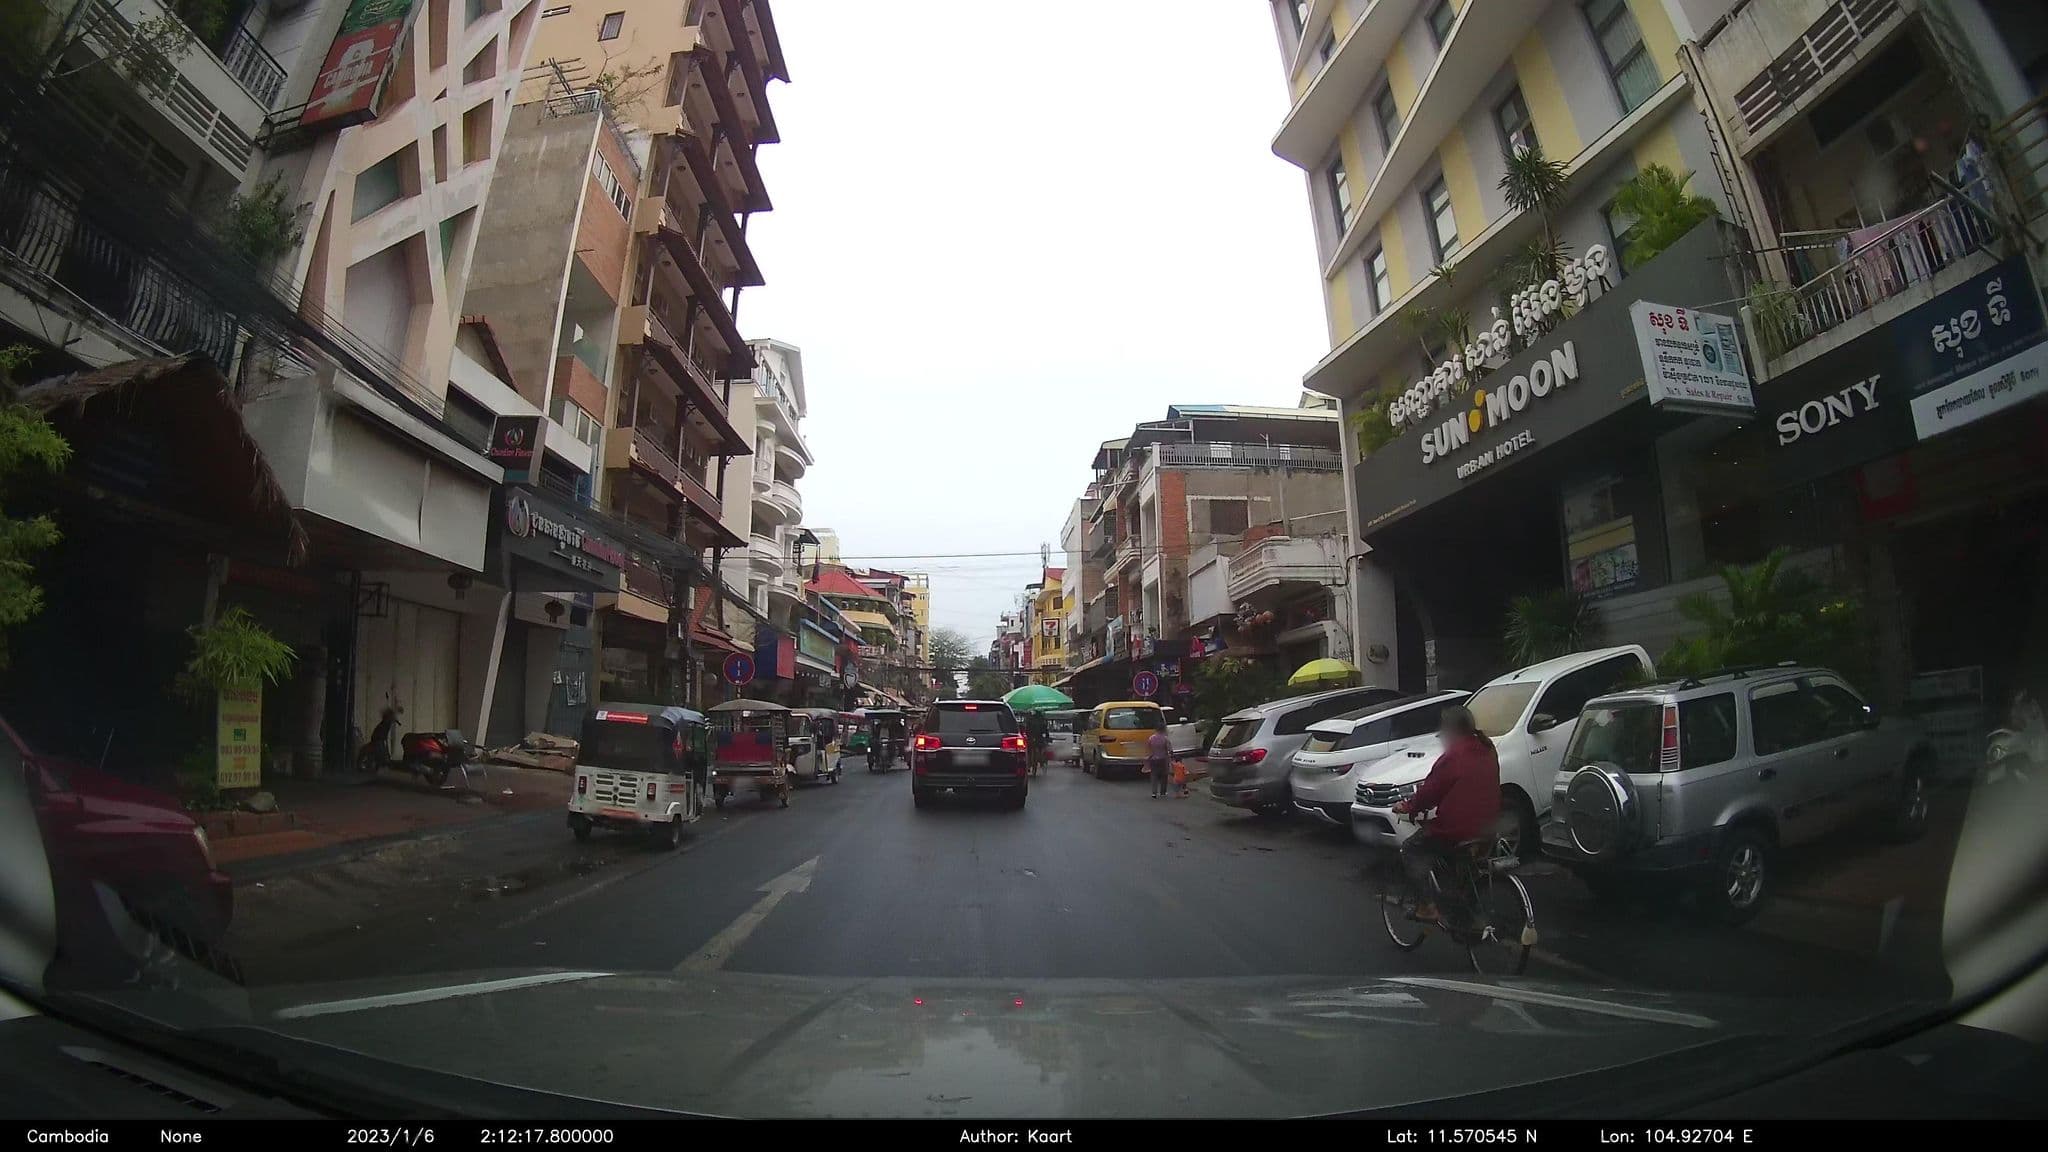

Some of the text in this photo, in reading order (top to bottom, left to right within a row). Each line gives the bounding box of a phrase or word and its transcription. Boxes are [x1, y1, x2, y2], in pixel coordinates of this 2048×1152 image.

[1421, 340, 1579, 464] SUN MOON
[1685, 387, 1704, 397] Sales
[1776, 373, 1881, 446] SONY
[1456, 429, 1536, 480] URBAN HOTEL
